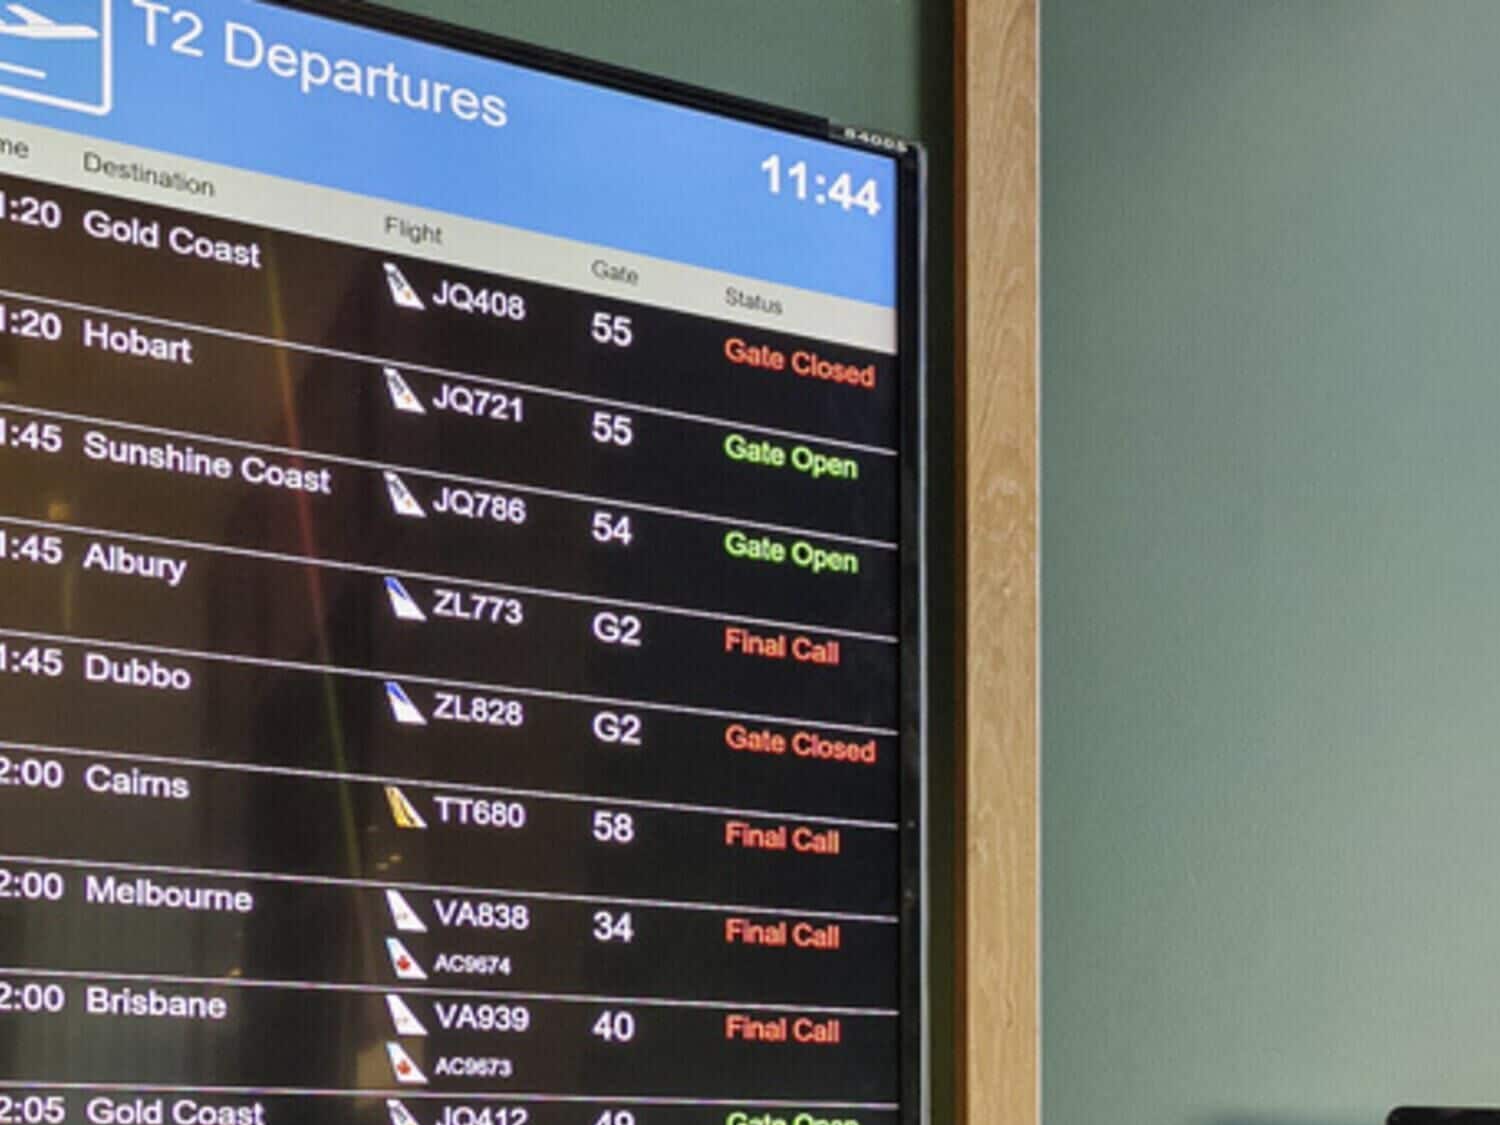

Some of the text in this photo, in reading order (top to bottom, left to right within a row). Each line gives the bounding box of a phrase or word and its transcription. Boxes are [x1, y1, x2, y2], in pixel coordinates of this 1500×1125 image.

[131, 0, 508, 128] T2 Departures
[83, 151, 214, 197] Destination
[761, 154, 881, 216] 11:44
[82, 209, 265, 269] Gold Coast
[384, 215, 443, 245] Flight
[591, 259, 639, 286] Gate
[432, 279, 525, 320] JQ408
[725, 286, 784, 316] Status
[83, 319, 193, 364] Hobart
[591, 311, 633, 347] 55
[724, 337, 879, 388] Gate Closed
[432, 384, 523, 422] JQ721
[591, 411, 633, 446] 55
[83, 429, 335, 494] Sunshine Coast
[724, 433, 859, 479] Gate Open
[432, 488, 526, 524] JQ786
[592, 511, 633, 545] 54
[82, 542, 187, 587] Albury
[724, 530, 859, 574] Gate Open
[433, 588, 524, 625] ZL773
[592, 611, 641, 647] G2
[725, 624, 840, 665] Final Call
[85, 652, 192, 690] Dubbo
[433, 690, 527, 727] ZL828
[592, 711, 641, 745] G2
[725, 724, 877, 764] Gate Closed
[84, 761, 193, 799] Cairns
[433, 795, 526, 828] TT680
[593, 810, 635, 843] 58
[725, 820, 840, 854] Final Call
[85, 874, 253, 912] Melbourne
[433, 899, 530, 930] VA838
[593, 911, 634, 943] 34
[725, 917, 840, 949] Final Call
[86, 986, 227, 1019] Brisbane
[434, 1002, 530, 1032] VA939
[592, 1010, 635, 1042] 40
[725, 1014, 840, 1043] Final Call
[86, 1096, 163, 1125] Gold
